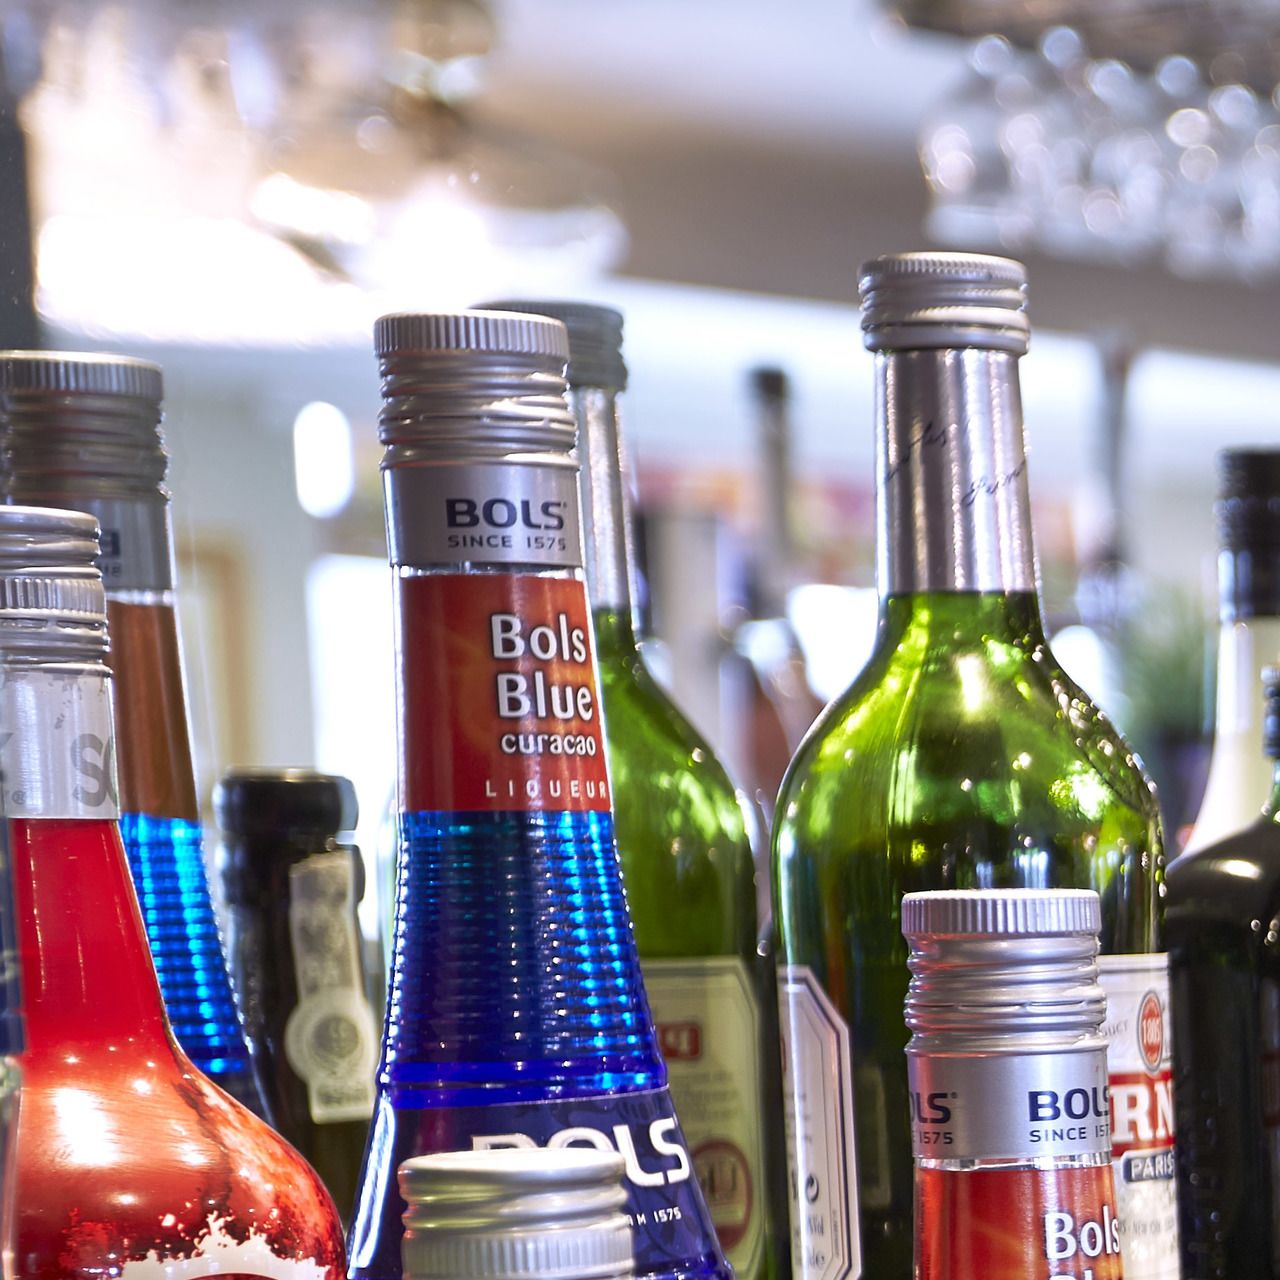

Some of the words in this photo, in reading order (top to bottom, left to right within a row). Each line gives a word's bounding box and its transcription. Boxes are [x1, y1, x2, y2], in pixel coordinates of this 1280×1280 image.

[446, 498, 564, 531] BOLS
[448, 534, 512, 549] SINCE
[527, 535, 566, 550] 1575
[491, 612, 586, 663] Bols
[497, 670, 593, 721] Blue
[501, 733, 596, 756] curacao
[485, 779, 606, 799] LIQUEUR
[919, 1131, 954, 1145] 1575
[1029, 1127, 1087, 1143] SINCE
[653, 1206, 682, 1224] 1575
[1044, 1205, 1120, 1262] Bols
